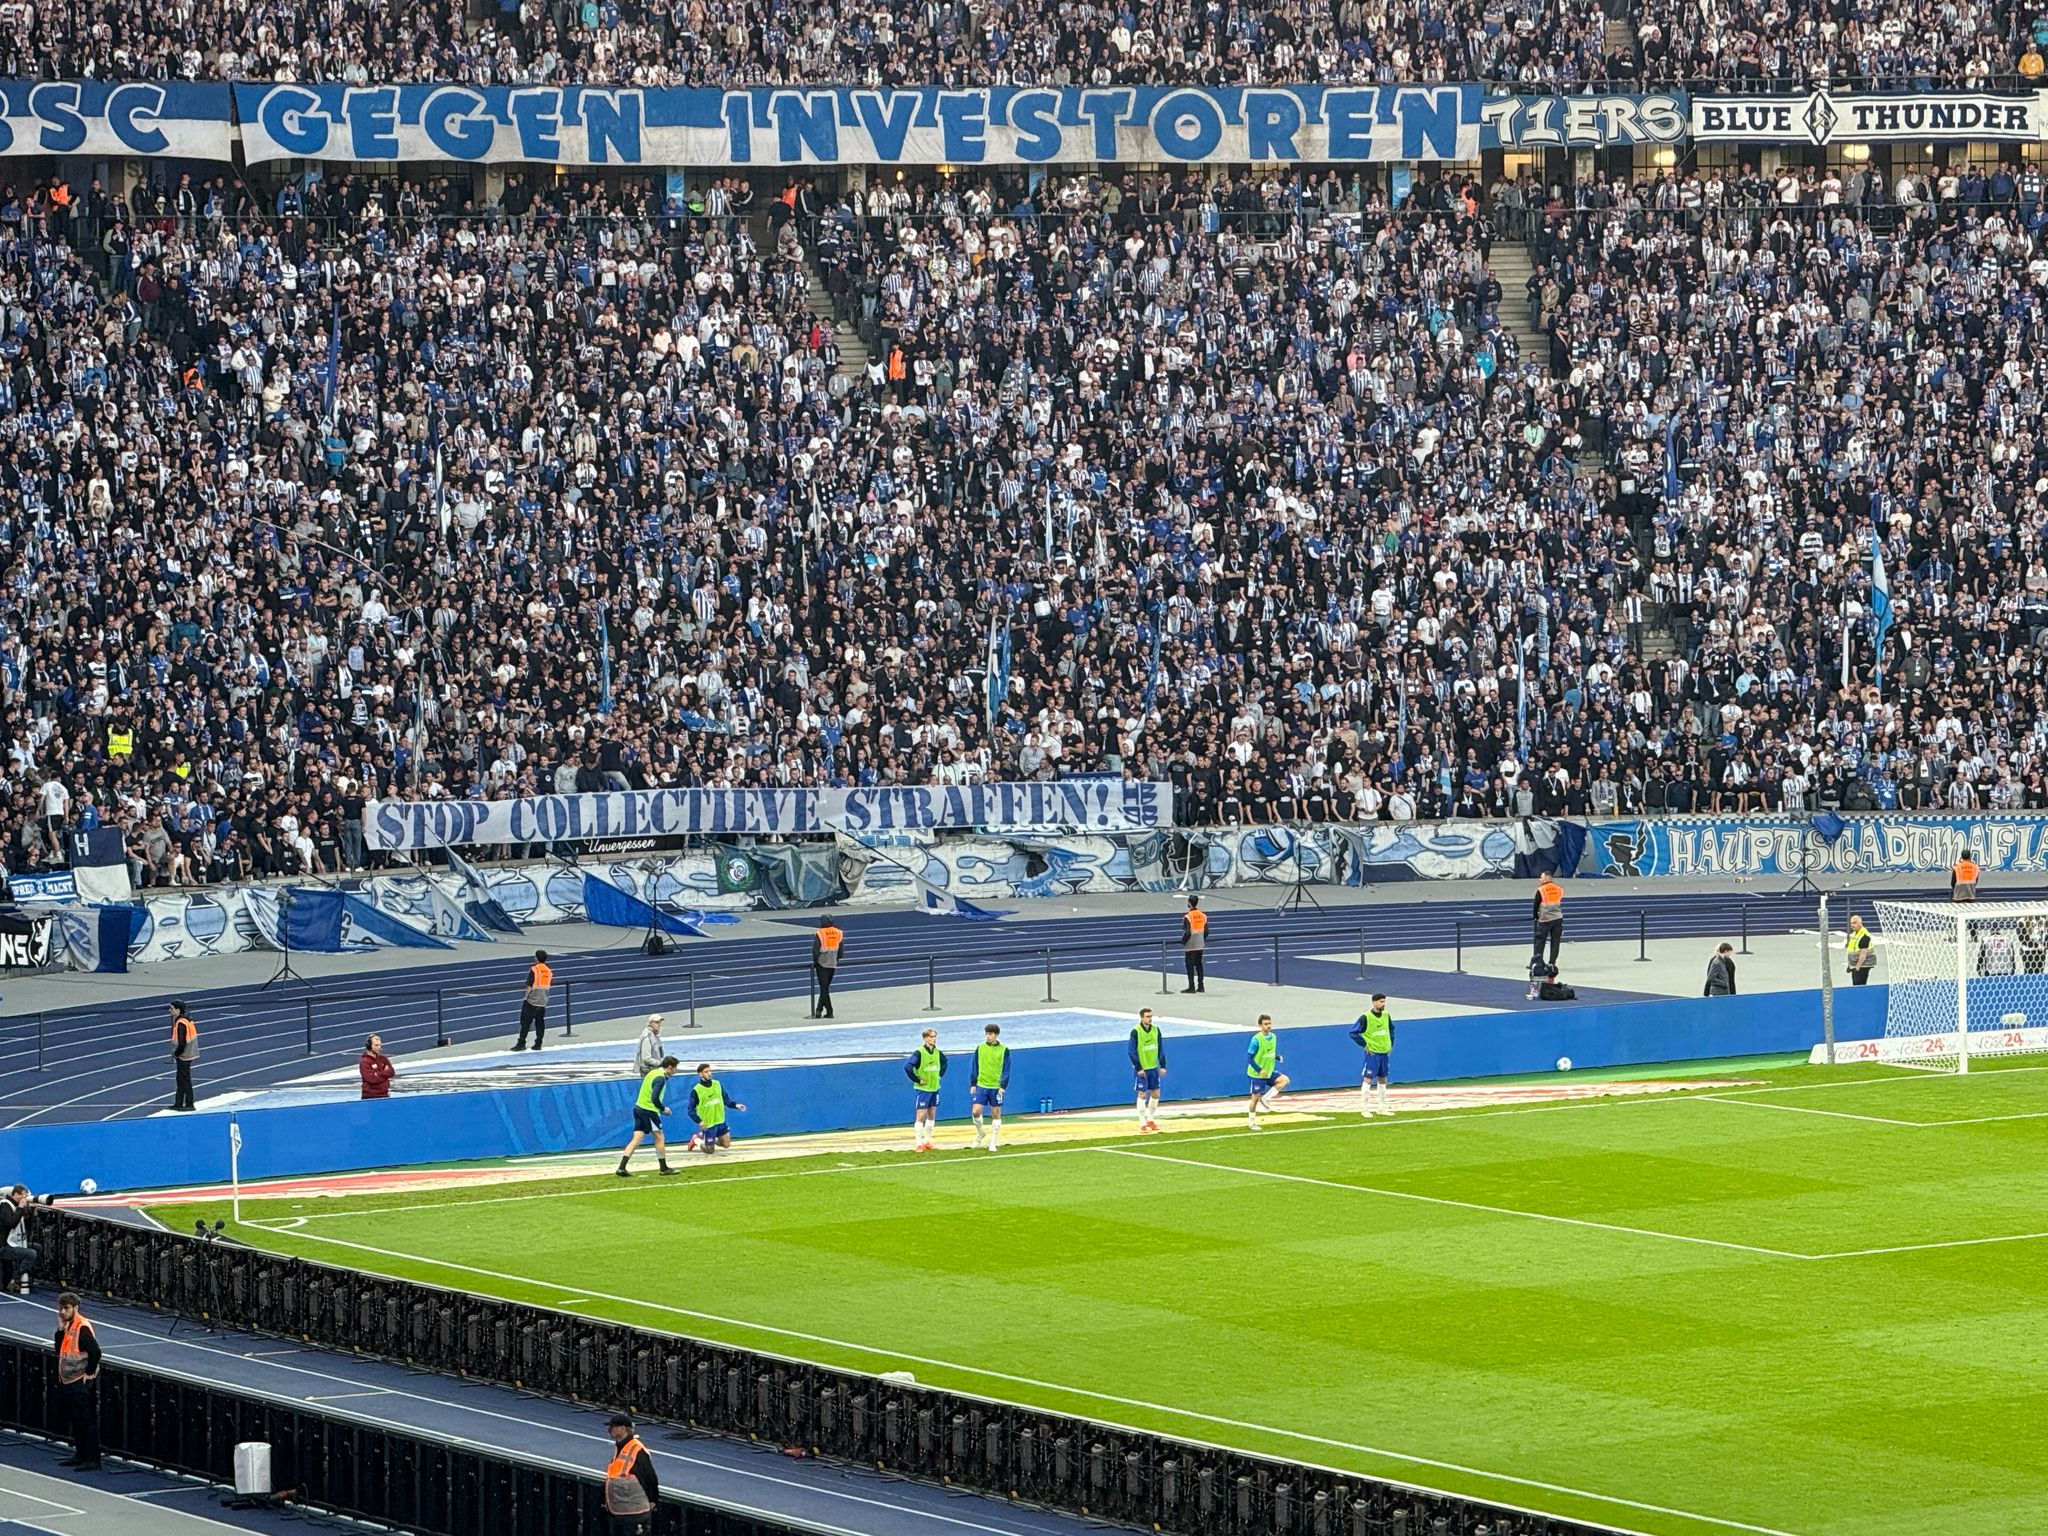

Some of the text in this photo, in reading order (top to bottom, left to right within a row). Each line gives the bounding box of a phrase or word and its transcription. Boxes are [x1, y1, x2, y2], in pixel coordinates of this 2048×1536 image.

[258, 84, 1463, 163] GEGEN INVESTOREN
[1481, 97, 1686, 145] 71ERS
[1702, 103, 2029, 132] BLUE THUNDER
[377, 782, 1109, 849] STOP COLLECTIEVE STRAFFEN!
[583, 838, 657, 854] Unvergessen
